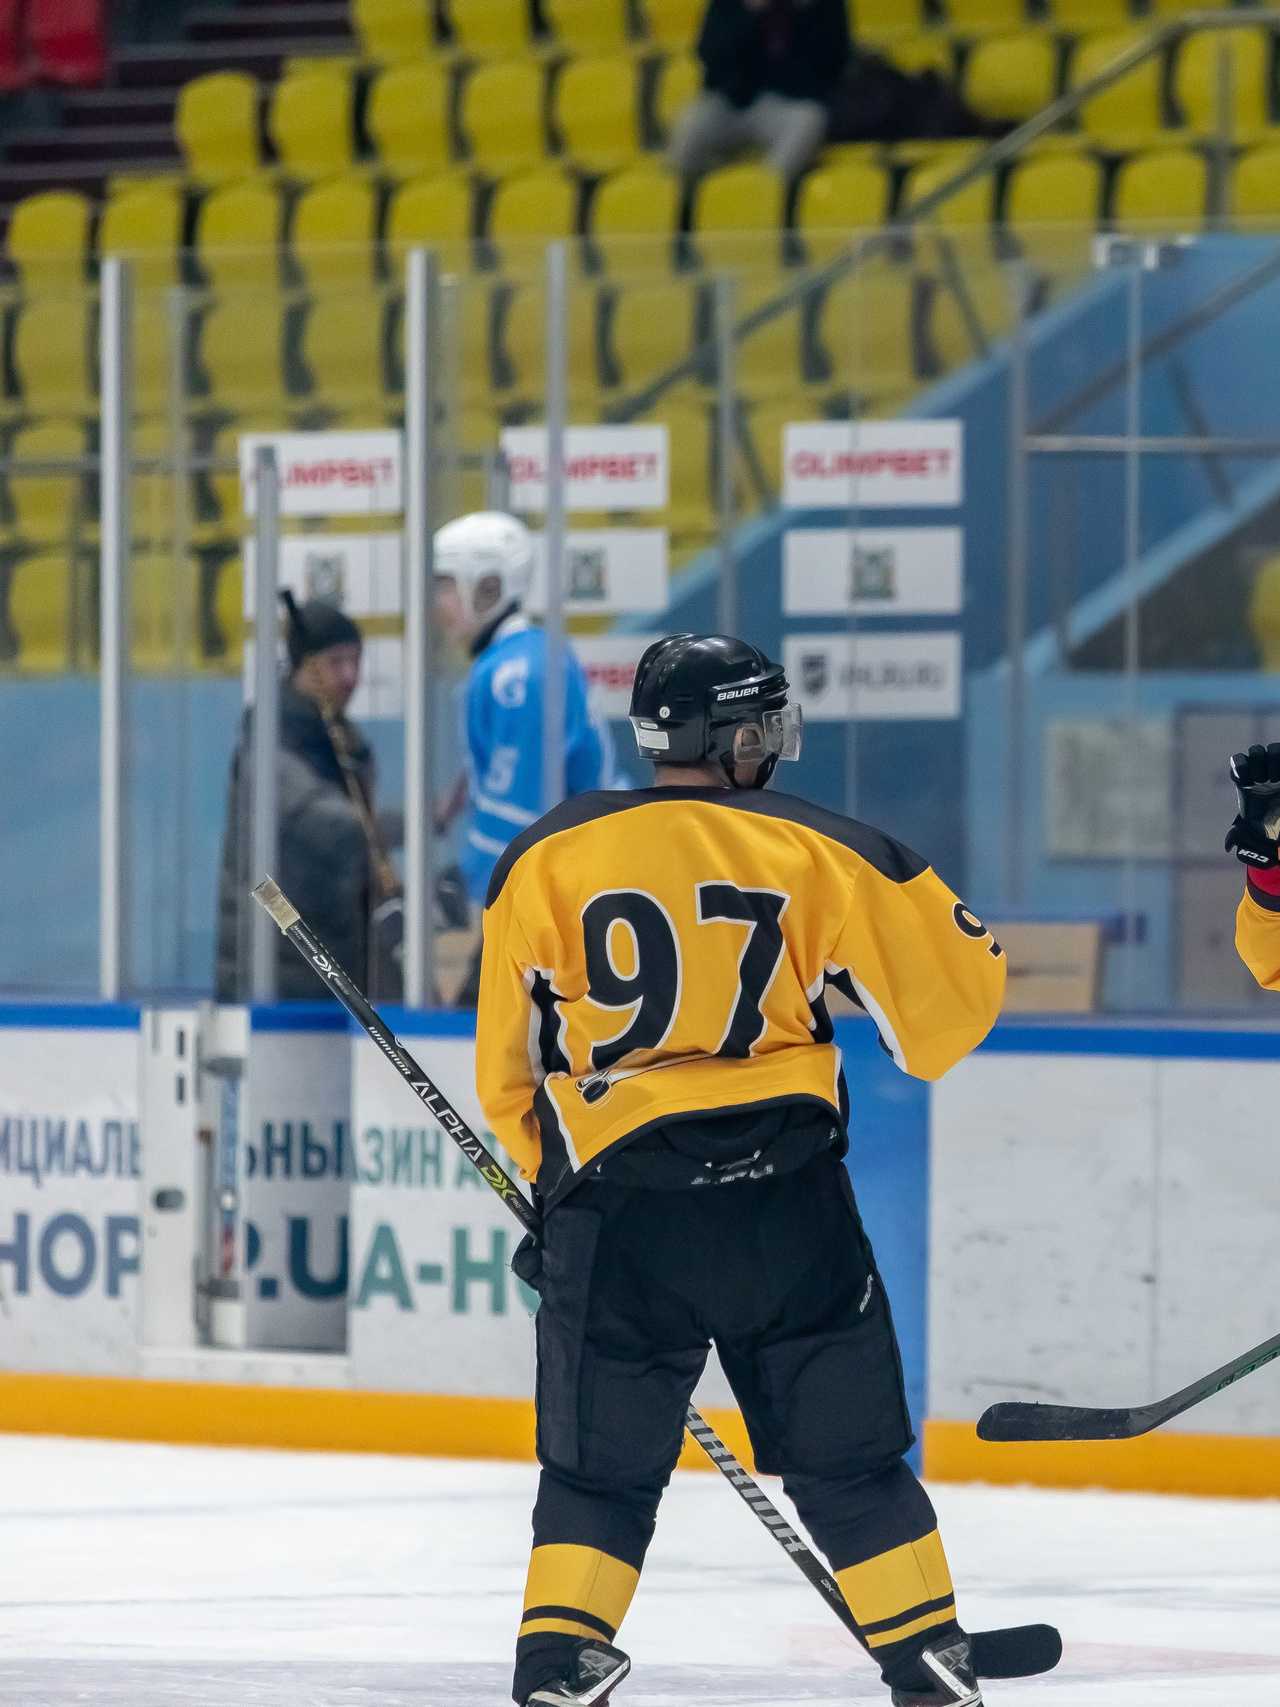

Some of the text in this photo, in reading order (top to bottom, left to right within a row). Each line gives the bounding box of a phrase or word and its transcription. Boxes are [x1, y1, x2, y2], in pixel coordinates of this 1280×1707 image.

[250, 457, 391, 488] IMPBET
[511, 453, 656, 484] OLMPBET
[791, 448, 951, 479] OLIMPBET
[717, 686, 759, 701] BAUER
[1238, 849, 1269, 863] CCM
[581, 880, 790, 1071] 97
[368, 1026, 411, 1075] WARRIOR
[411, 1081, 483, 1162] ALPHA
